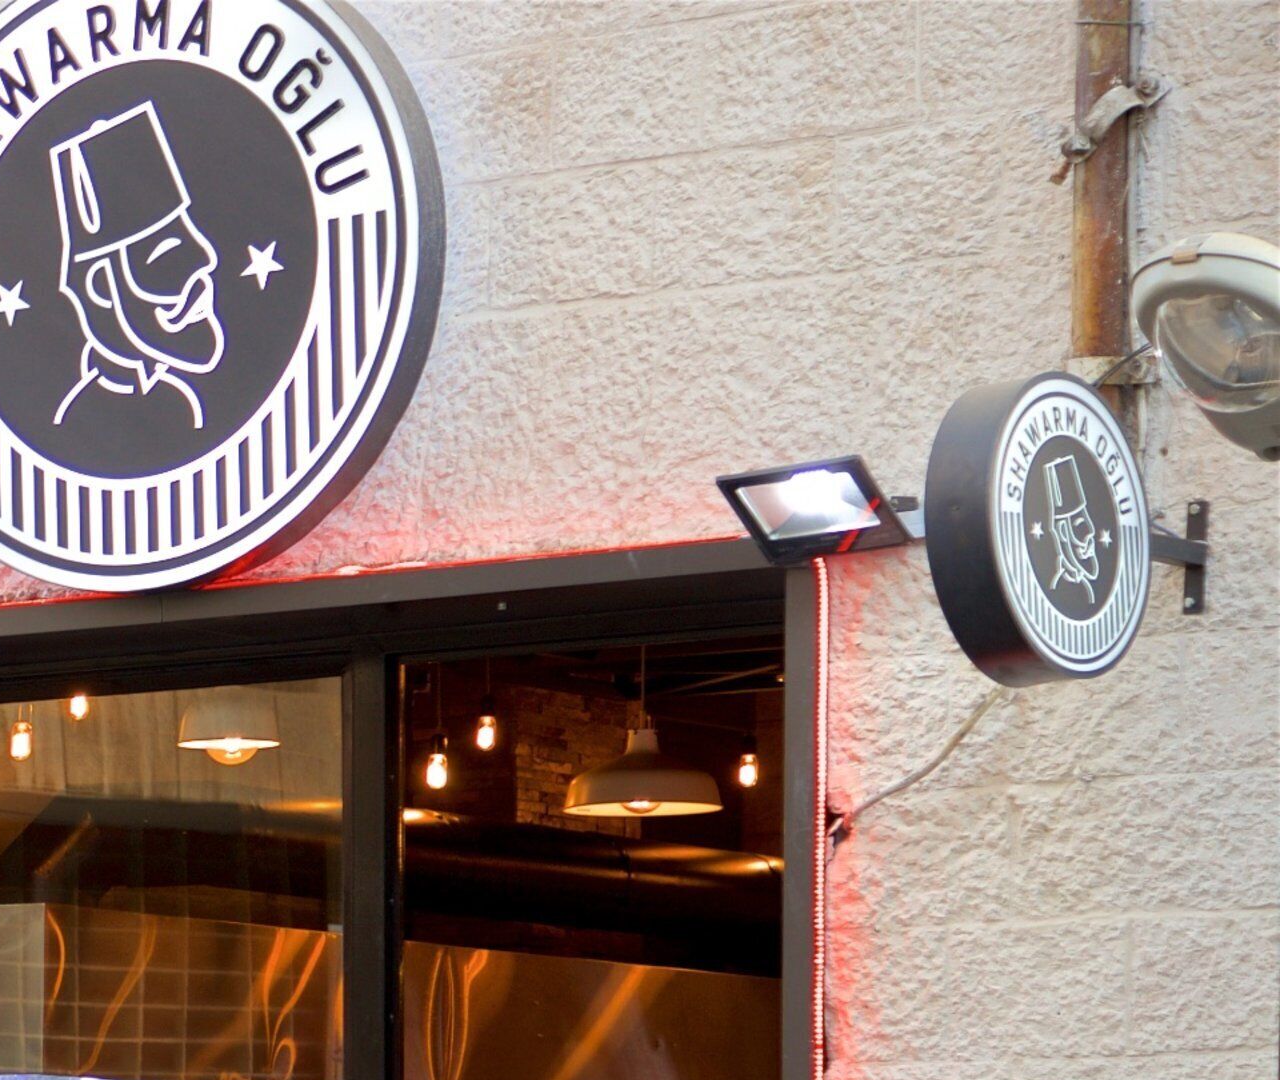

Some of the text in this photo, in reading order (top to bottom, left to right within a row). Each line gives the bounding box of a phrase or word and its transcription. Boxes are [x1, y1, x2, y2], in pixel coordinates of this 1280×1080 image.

[238, 22, 370, 197] OĞLU
[1006, 406, 1133, 516] SHAWARMA OĞLU
